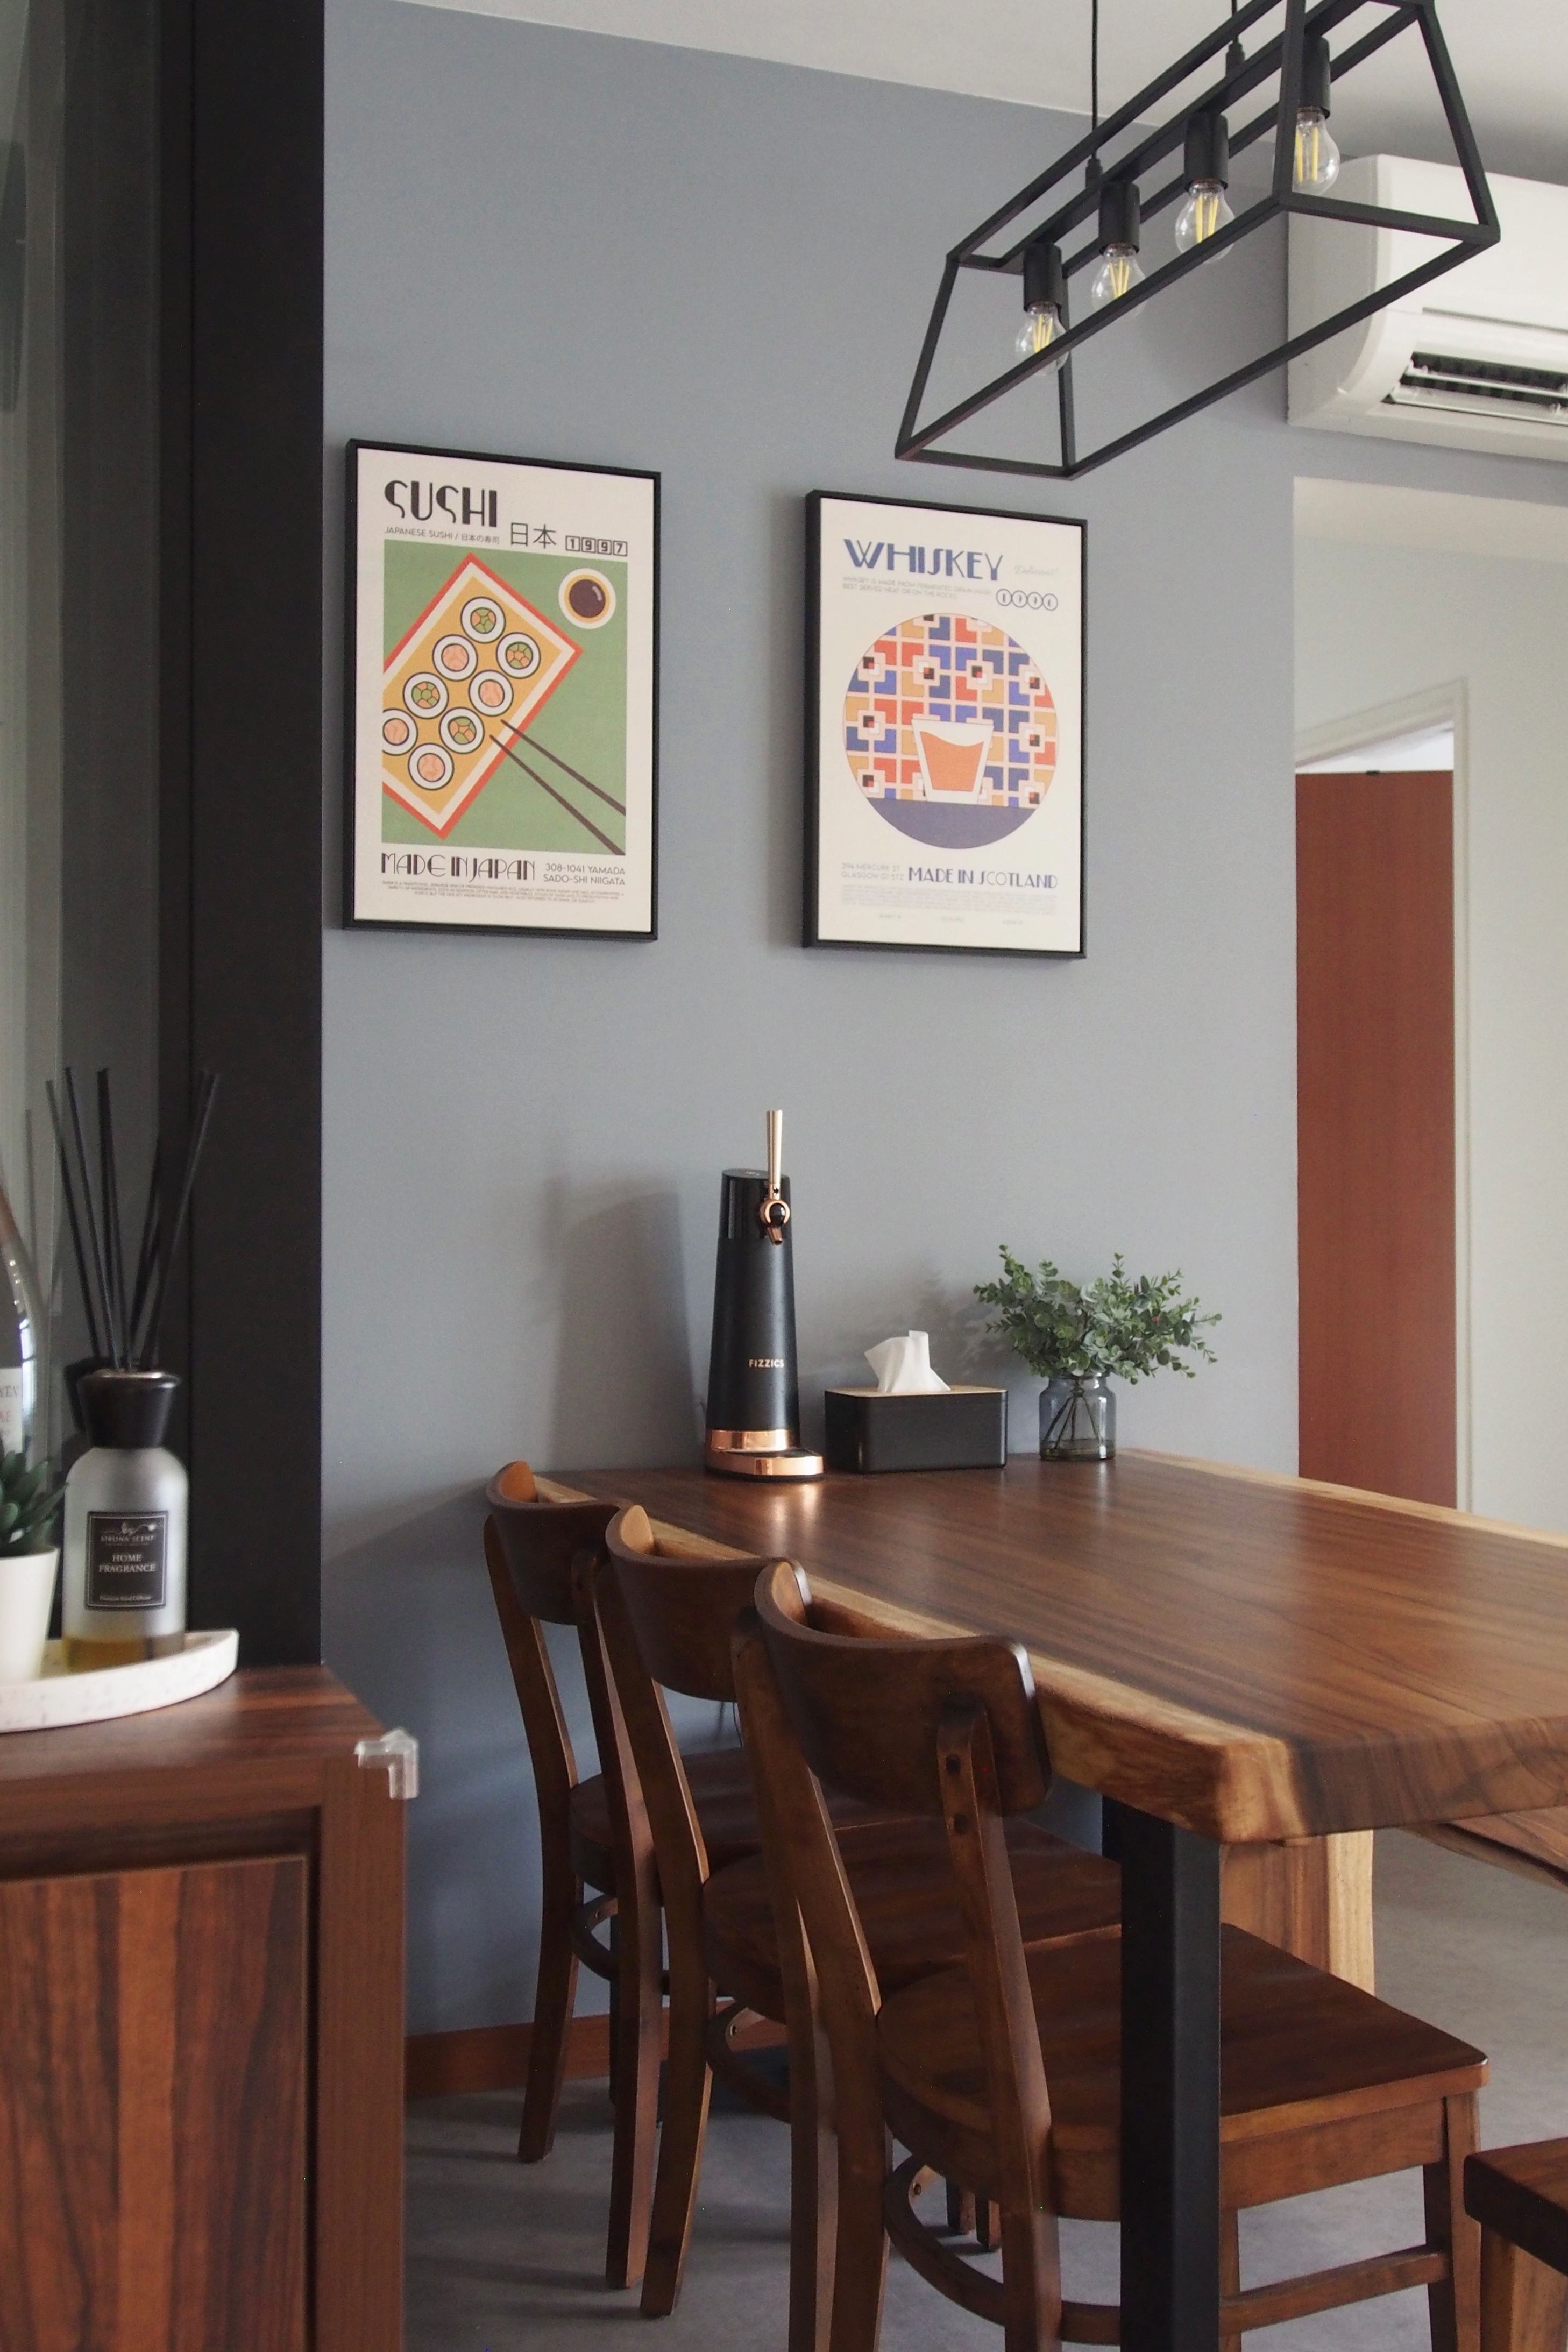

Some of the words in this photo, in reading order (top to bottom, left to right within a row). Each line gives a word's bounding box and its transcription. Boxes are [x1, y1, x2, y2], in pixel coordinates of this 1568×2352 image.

[385, 480, 497, 527] SUSHI
[385, 526, 425, 537] JAPANESE
[429, 530, 452, 539] SUSHI
[510, 522, 557, 549] 日本
[567, 537, 625, 555] 1997
[843, 539, 1003, 581] WHISKEY
[381, 853, 445, 877] MADE
[451, 856, 468, 877] IN
[469, 858, 535, 882] JAPAN
[545, 863, 585, 873] 308-1041
[587, 866, 626, 875] YAMADA
[543, 874, 588, 883] SADO-SHI
[590, 877, 626, 885] NIIGATA
[908, 867, 953, 883] MADE
[957, 869, 974, 884] IN
[978, 870, 1058, 888] SCOTLAND
[749, 1359, 784, 1368] FIZZICS
[112, 1554, 142, 1562] HOME
[98, 1564, 156, 1573] FRAGRANCE
